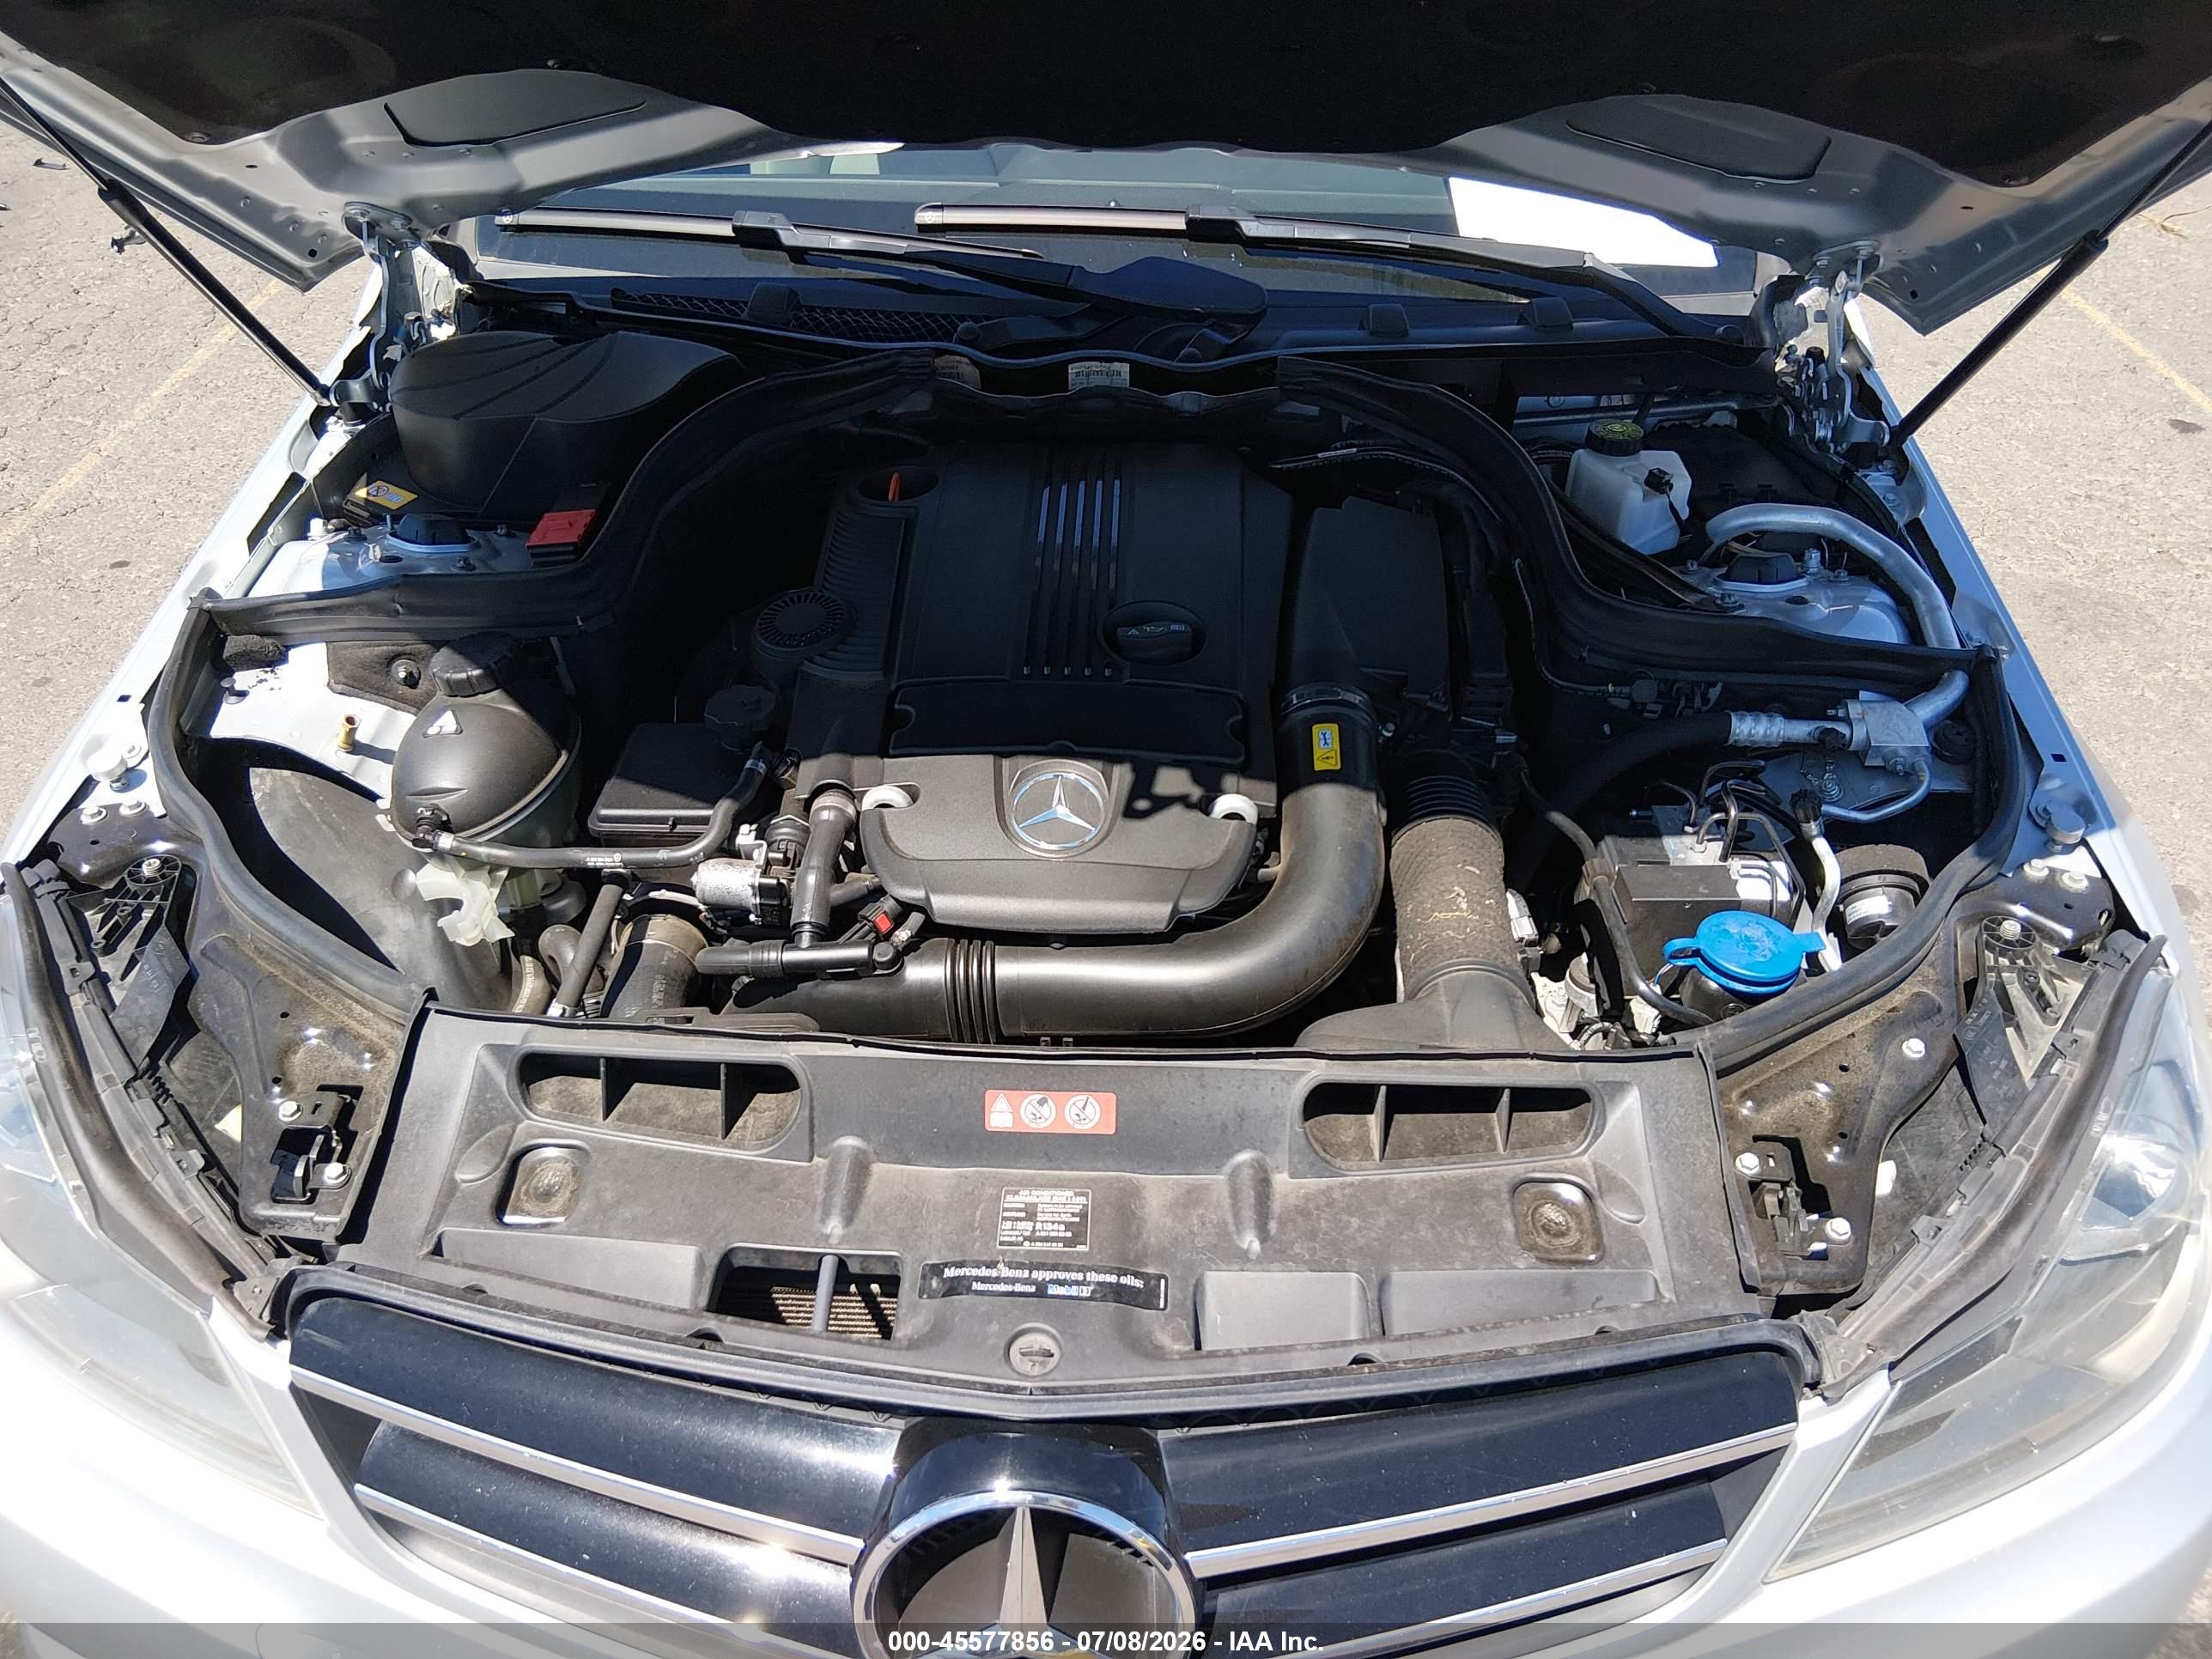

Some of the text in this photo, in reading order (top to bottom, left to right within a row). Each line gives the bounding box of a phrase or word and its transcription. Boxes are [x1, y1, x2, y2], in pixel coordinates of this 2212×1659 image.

[943, 1266, 1145, 1289] Mercedes-Benz approves these oils:
[971, 1280, 1036, 1293] Mercedes-Benz
